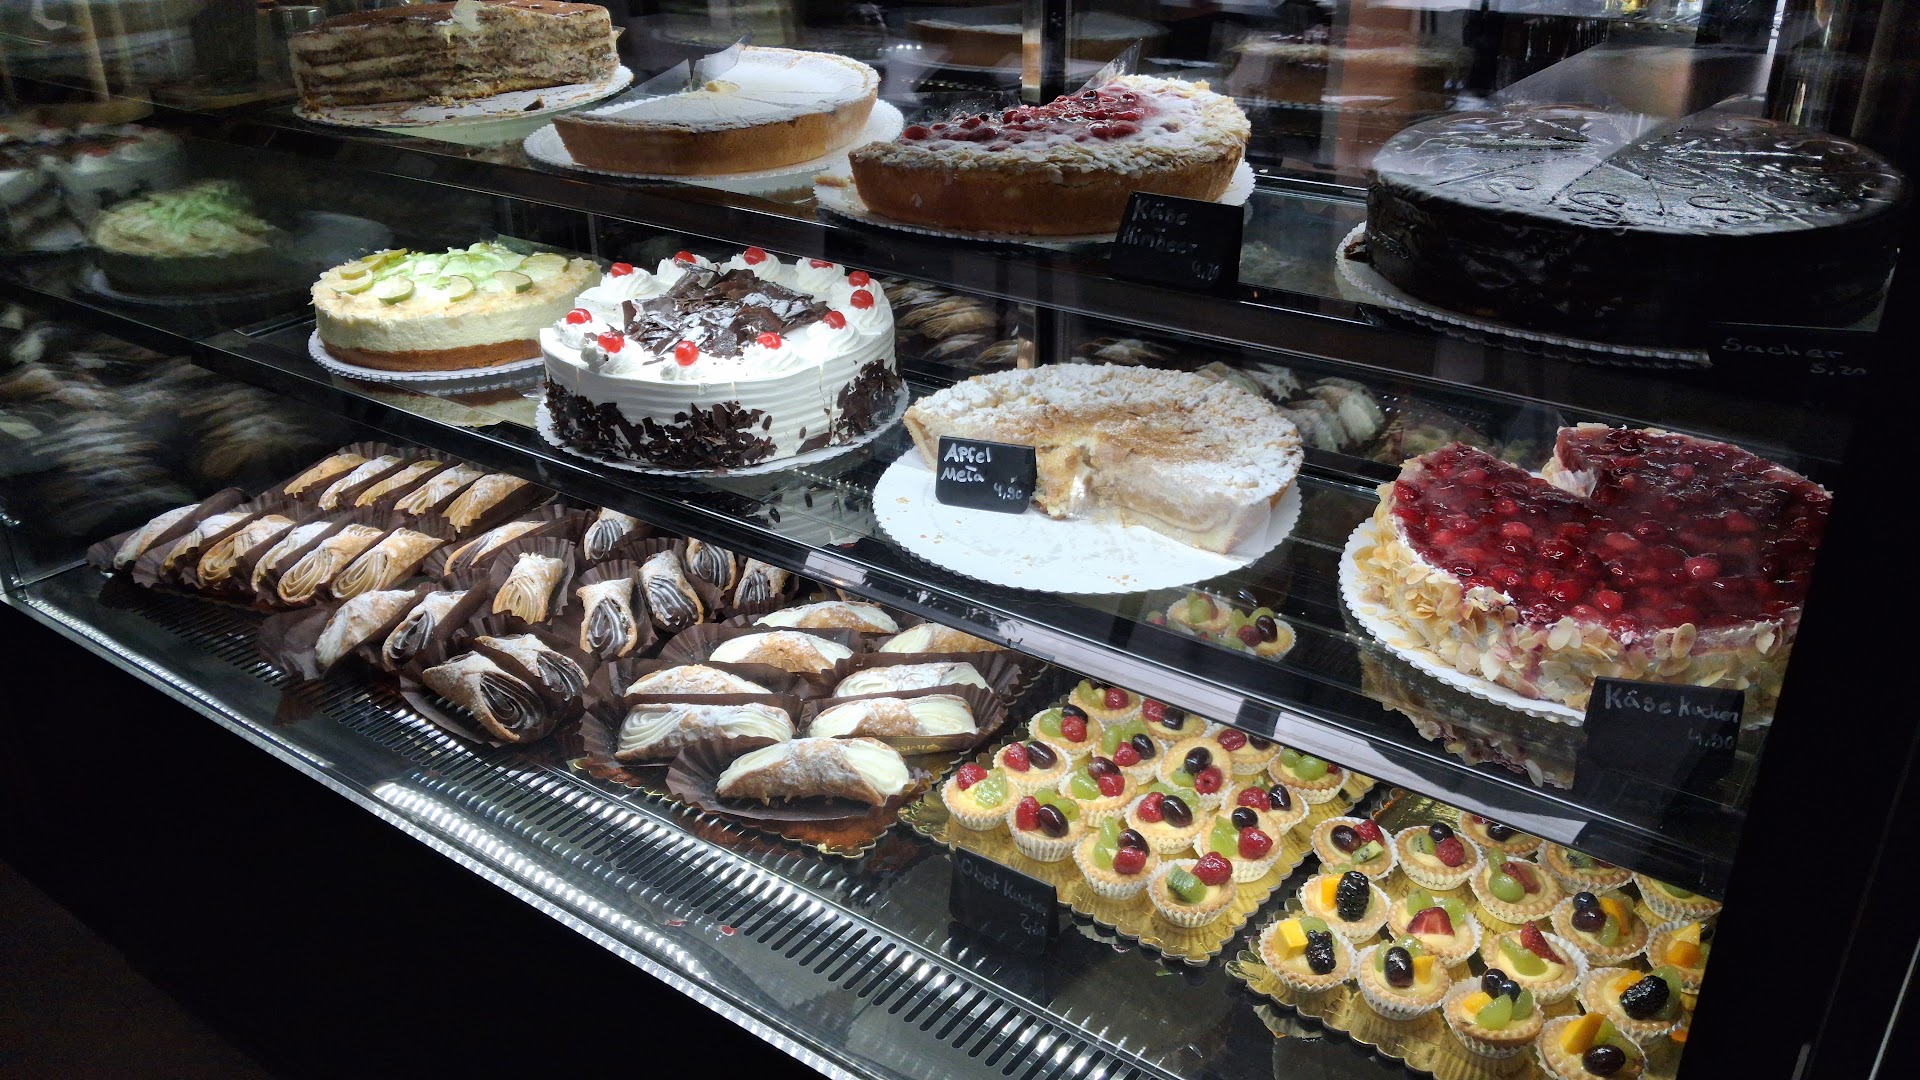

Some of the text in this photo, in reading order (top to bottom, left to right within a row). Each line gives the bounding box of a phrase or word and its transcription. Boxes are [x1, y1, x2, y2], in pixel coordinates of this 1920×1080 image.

[1131, 198, 1189, 226] Käse
[1720, 336, 1845, 359] Sacher
[993, 482, 1023, 501] 4,90
[1604, 682, 1673, 714] Käse
